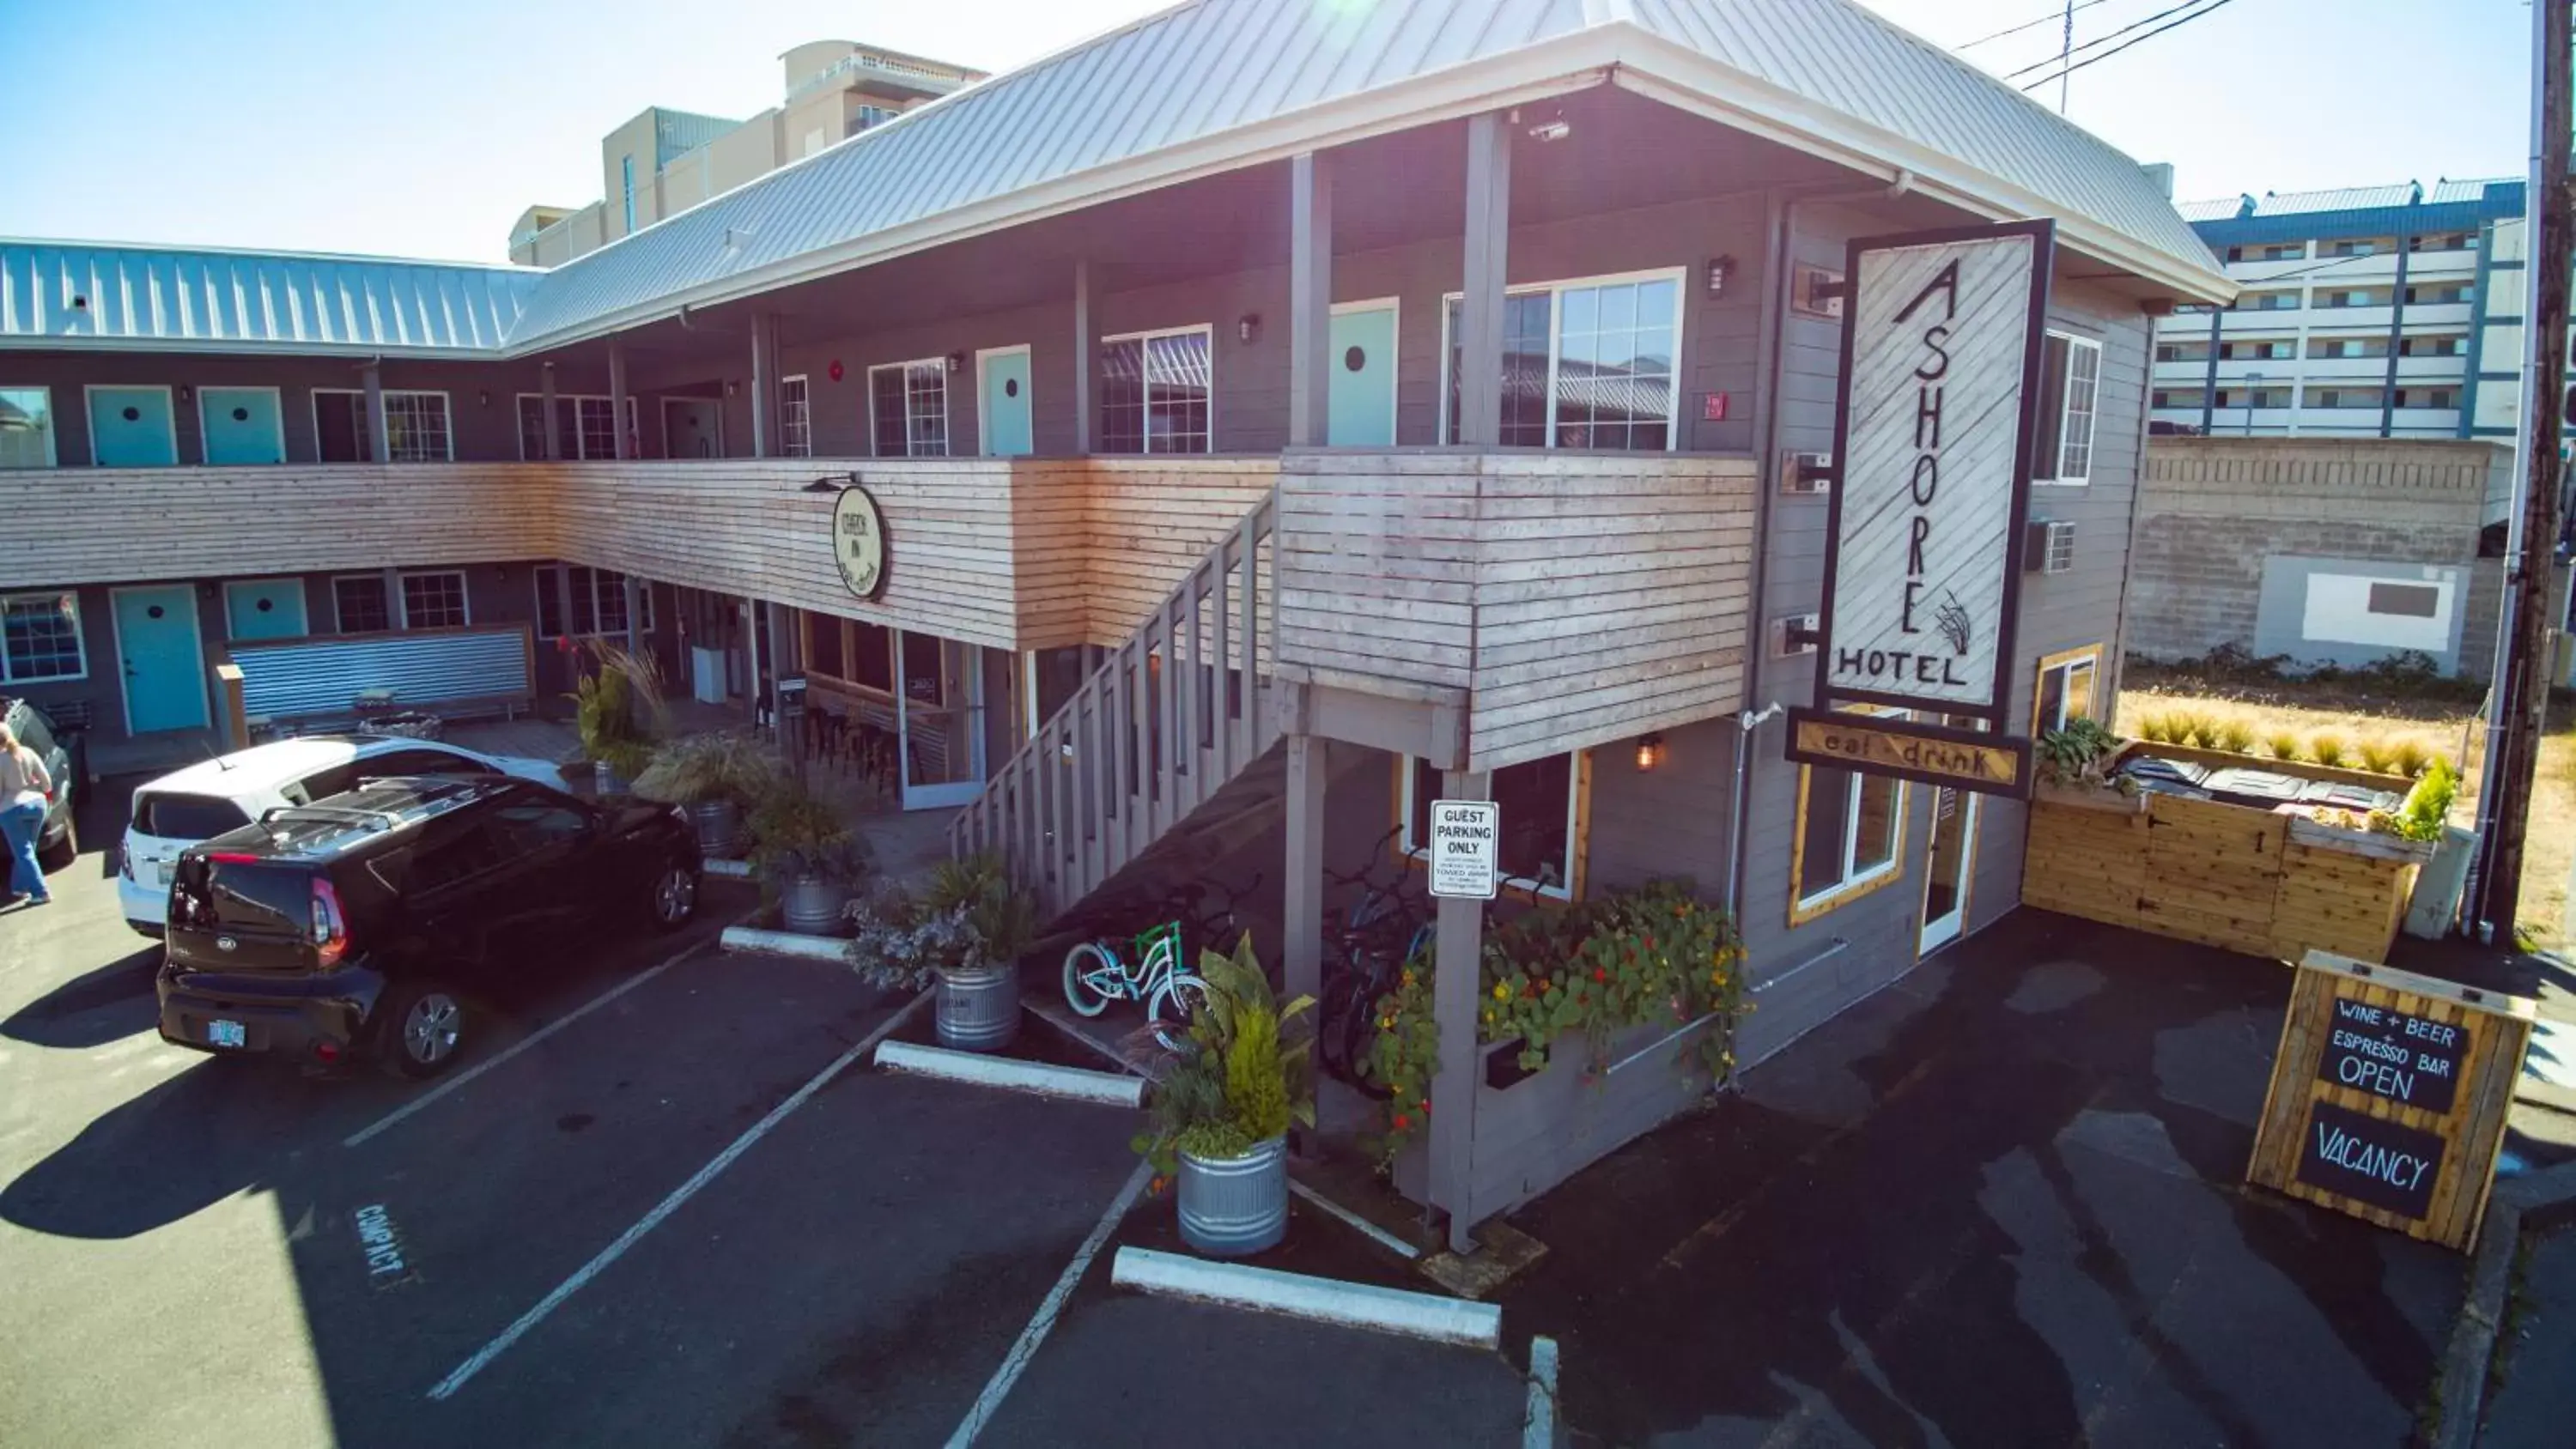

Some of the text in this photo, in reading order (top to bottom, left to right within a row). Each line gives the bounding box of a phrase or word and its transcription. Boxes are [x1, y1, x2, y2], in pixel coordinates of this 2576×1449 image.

[1893, 258, 1960, 634] ASHORE
[1838, 647, 1967, 686] HOTEL
[1903, 740, 1987, 775] drink
[1437, 825, 1492, 839] PARKING
[1444, 809, 1485, 823] GUEST
[1448, 841, 1479, 854] ONLY
[2339, 1000, 2382, 1026] WINE
[2405, 1018, 2456, 1047] BEER
[2333, 1029, 2450, 1078] ESPRESSO BAR
[2339, 1055, 2414, 1100] OPEN
[2318, 1121, 2429, 1191] VACANCY
[355, 1204, 404, 1275] COMPACT
